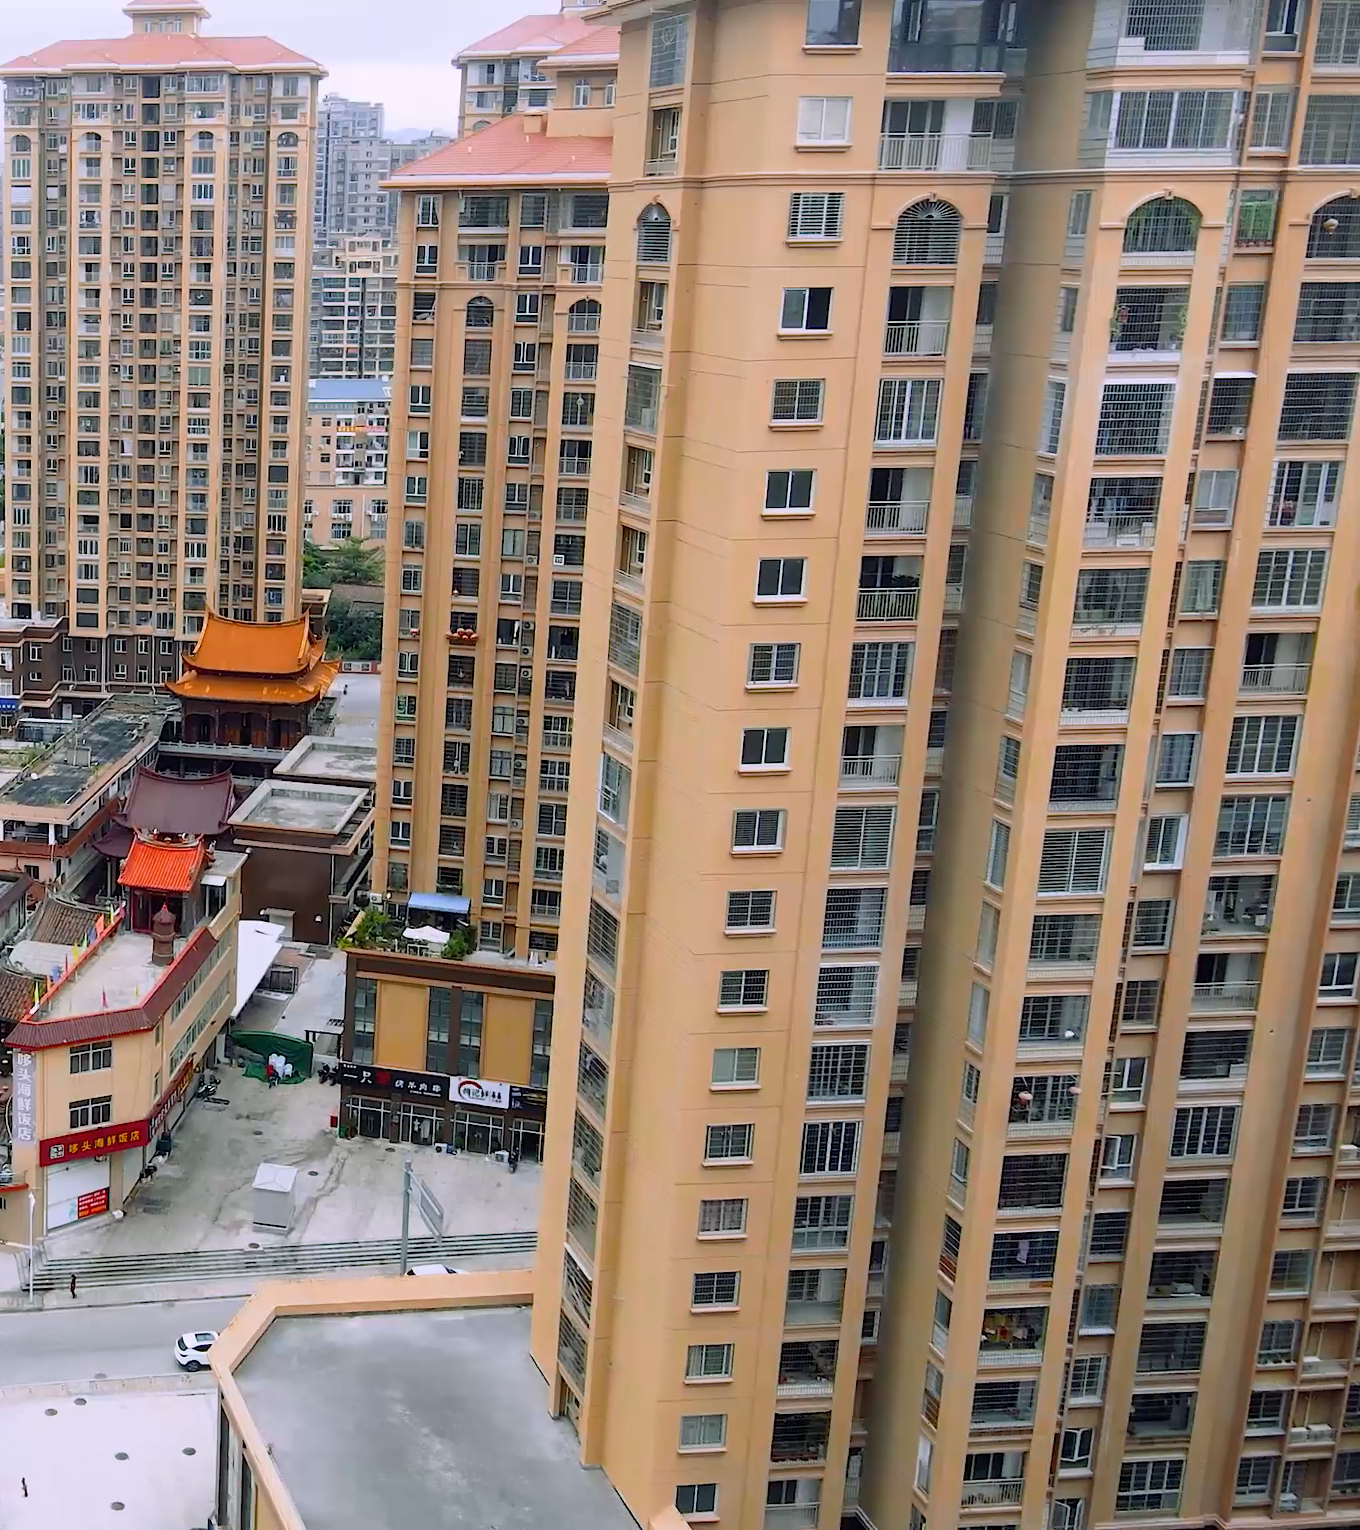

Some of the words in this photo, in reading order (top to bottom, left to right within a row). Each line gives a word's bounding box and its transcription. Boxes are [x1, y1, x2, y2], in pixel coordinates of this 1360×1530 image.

[68, 1130, 140, 1154] 哆头海鲜饭店
